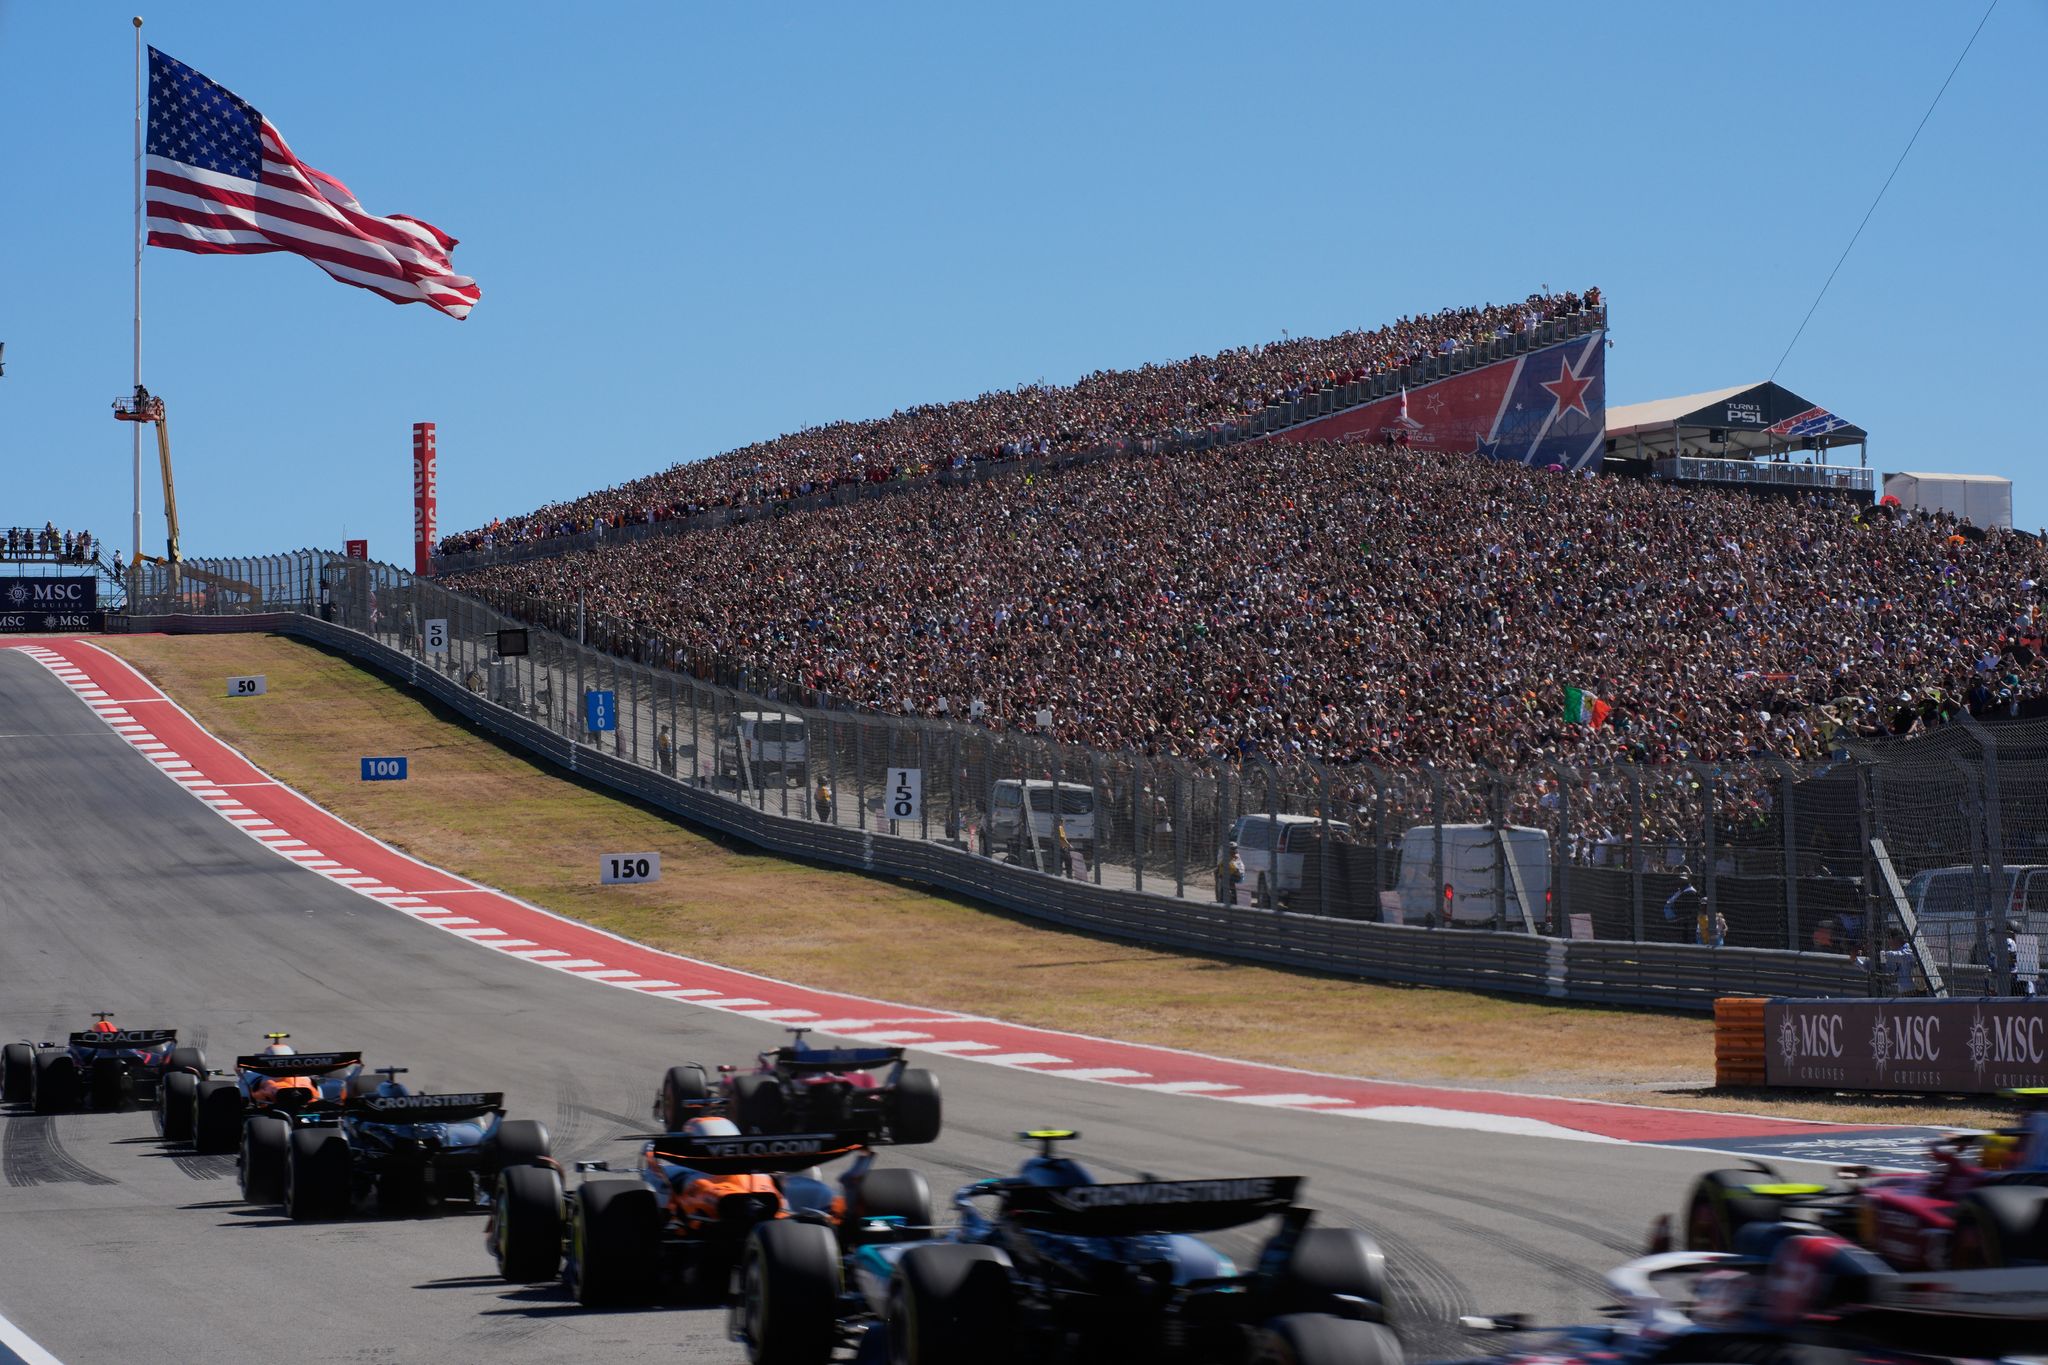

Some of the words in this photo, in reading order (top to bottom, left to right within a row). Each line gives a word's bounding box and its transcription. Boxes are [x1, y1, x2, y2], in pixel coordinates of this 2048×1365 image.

[1727, 402, 1754, 411] TURN
[1727, 410, 1768, 424] PSL
[33, 584, 81, 600] MSC
[59, 615, 89, 626] MSC
[429, 625, 443, 647] 50
[238, 679, 256, 693] 50
[597, 694, 606, 728] 100
[368, 761, 399, 776] 100
[894, 771, 912, 816] 150
[611, 858, 650, 879] 150
[82, 1030, 165, 1043] ORACLE
[1800, 1014, 1844, 1058] MSC
[1894, 1015, 1940, 1061] MSC
[1993, 1015, 2044, 1064] MSC
[268, 1057, 333, 1068] VELO.COM
[376, 1094, 485, 1109] CROWDSTRIKE
